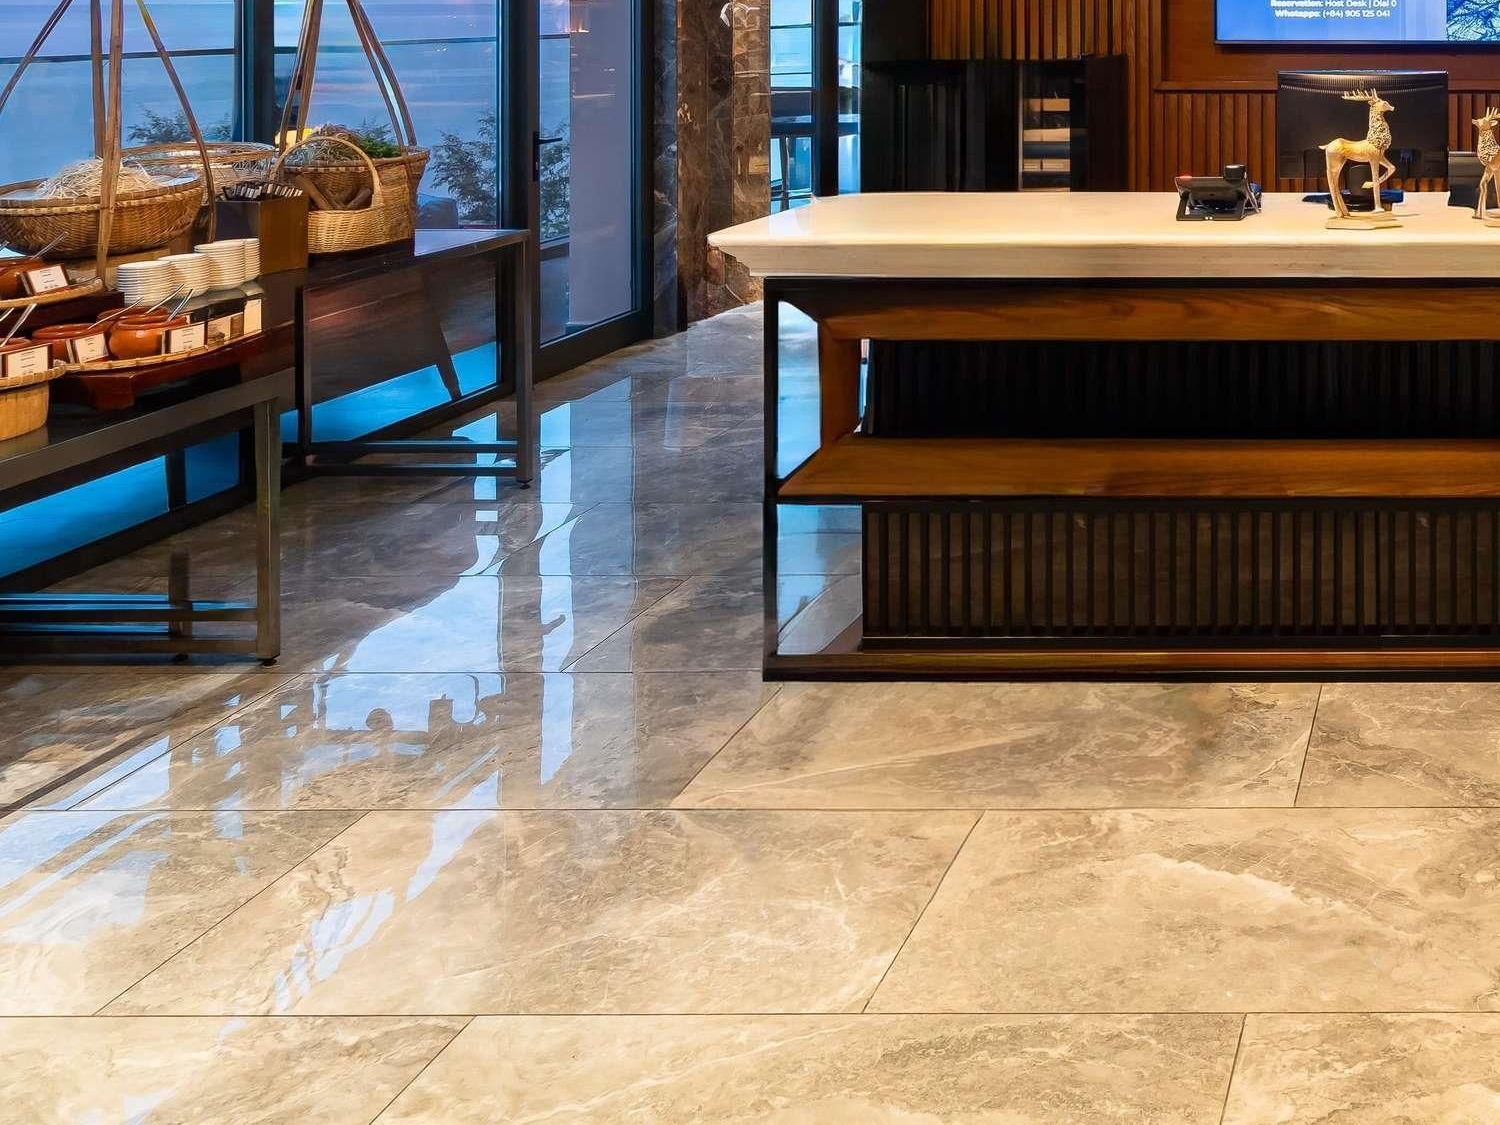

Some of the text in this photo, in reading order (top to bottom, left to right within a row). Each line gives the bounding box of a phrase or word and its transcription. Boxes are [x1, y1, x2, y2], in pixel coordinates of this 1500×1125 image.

[1325, 0, 1345, 7] Host
[1346, 0, 1368, 7] Desk
[1373, 0, 1390, 7] Dial
[1322, 9, 1344, 19] (+84)
